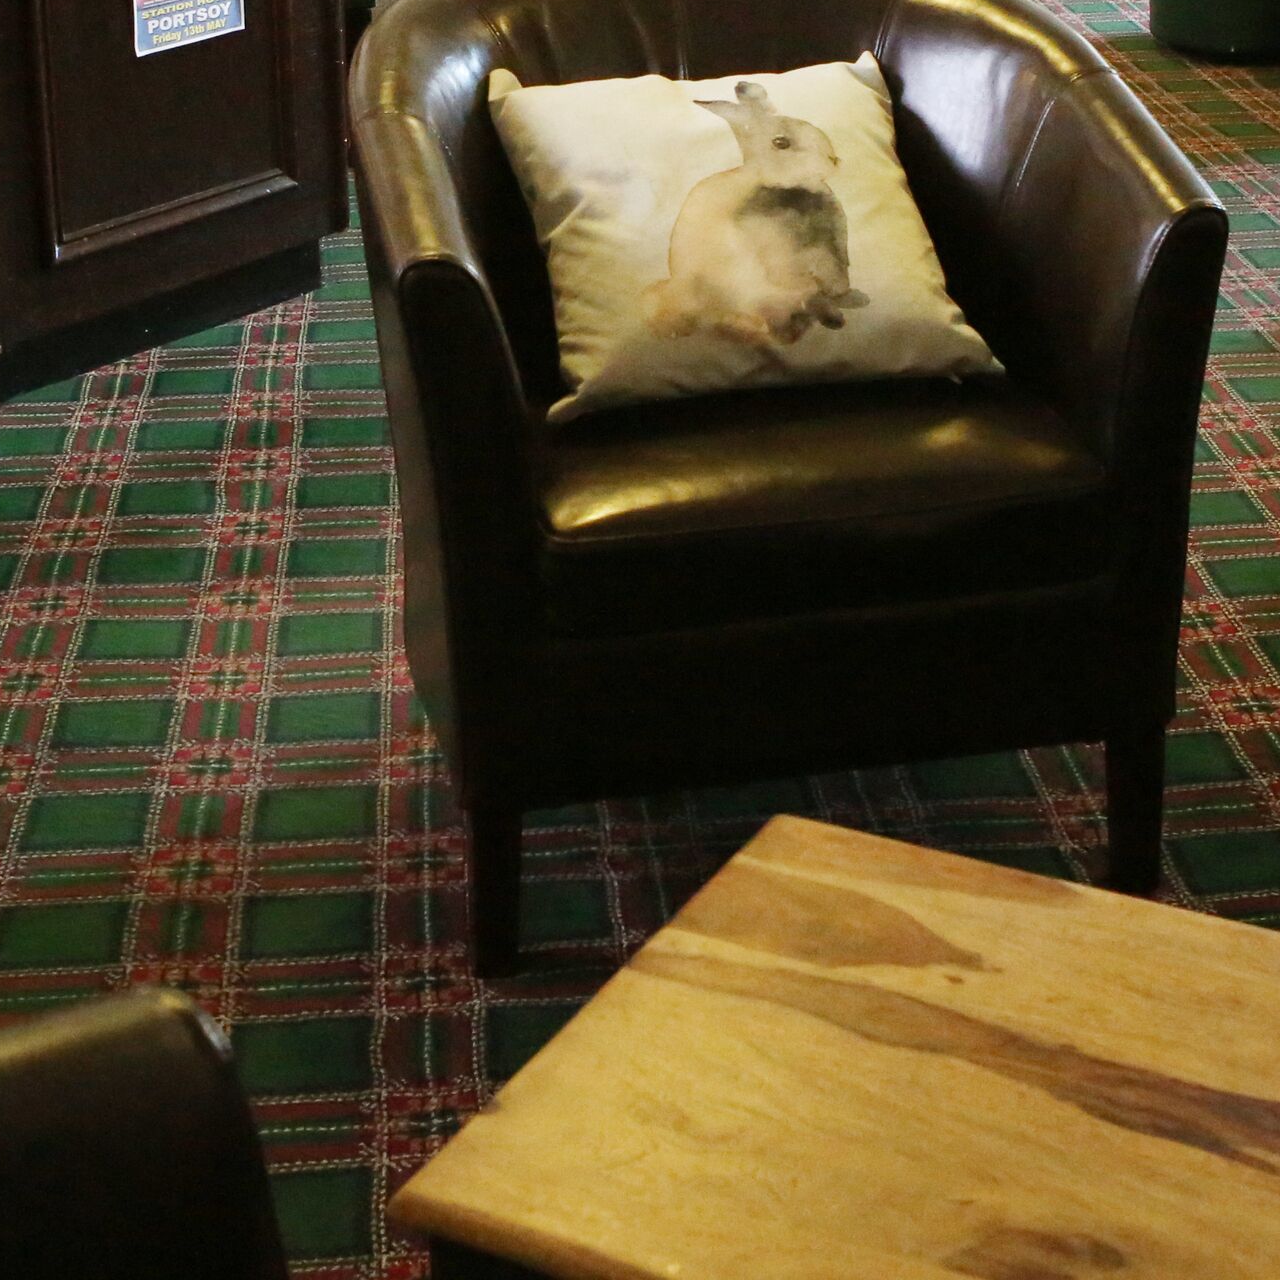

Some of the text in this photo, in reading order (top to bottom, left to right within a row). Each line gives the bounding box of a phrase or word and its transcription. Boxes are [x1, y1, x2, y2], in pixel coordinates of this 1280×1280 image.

[141, 0, 193, 19] STATION
[147, 1, 232, 34] PORTSOY
[153, 18, 227, 45] Friday 13th MAY
